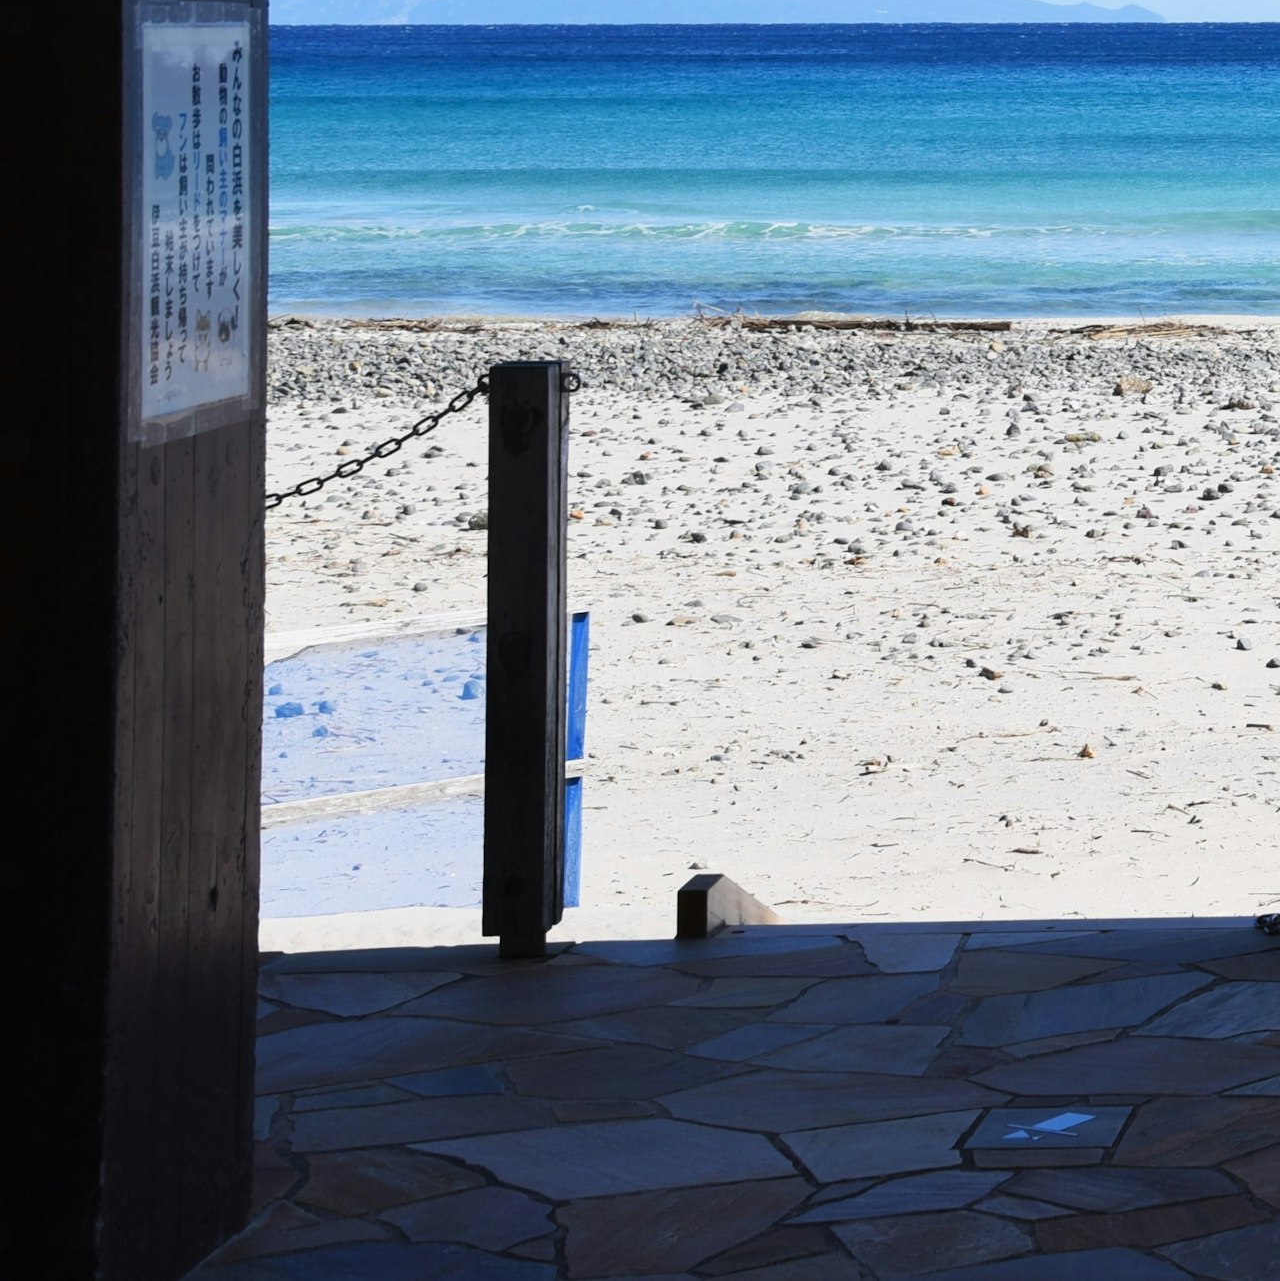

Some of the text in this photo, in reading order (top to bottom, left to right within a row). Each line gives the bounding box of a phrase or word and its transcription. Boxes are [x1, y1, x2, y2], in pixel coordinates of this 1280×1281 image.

[178, 113, 188, 363] フンは飼い主が持ち帰って
[192, 64, 201, 293] お散歩はリードをつけて
[206, 154, 215, 299] 問われています
[165, 231, 174, 381] 始末しましょう
